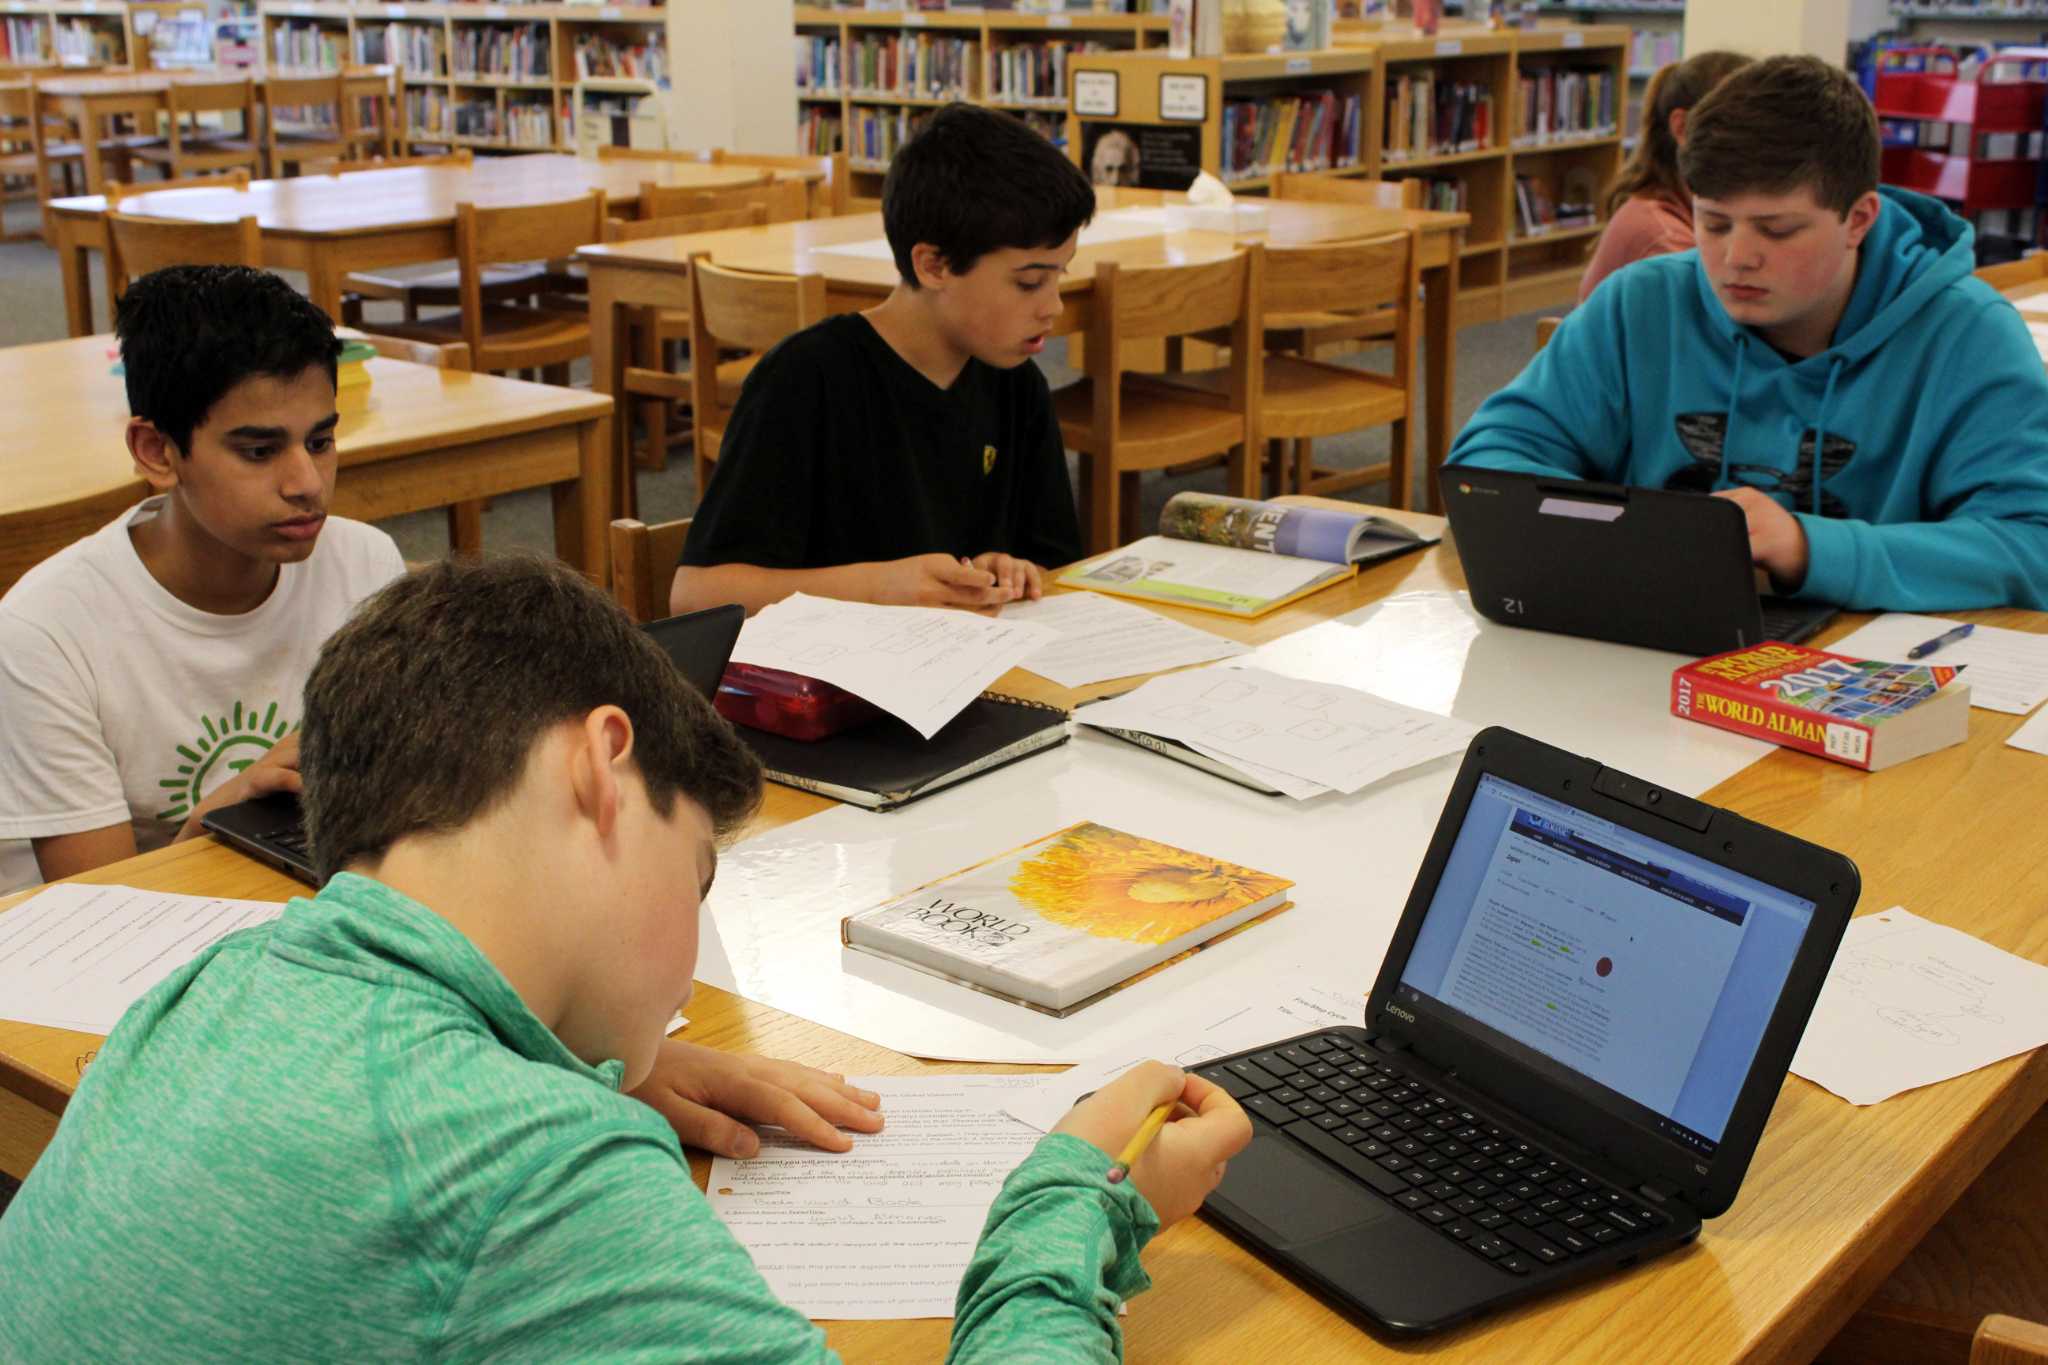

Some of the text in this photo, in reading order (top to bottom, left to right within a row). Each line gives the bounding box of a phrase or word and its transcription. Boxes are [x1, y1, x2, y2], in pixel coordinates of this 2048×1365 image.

[1760, 658, 1865, 697] 2017
[1677, 677, 1692, 716] 2017
[1704, 693, 1764, 727] WORLD
[903, 907, 979, 939] BOOK
[928, 898, 1031, 936] WORLD
[1385, 1001, 1416, 1023] Lenovo
